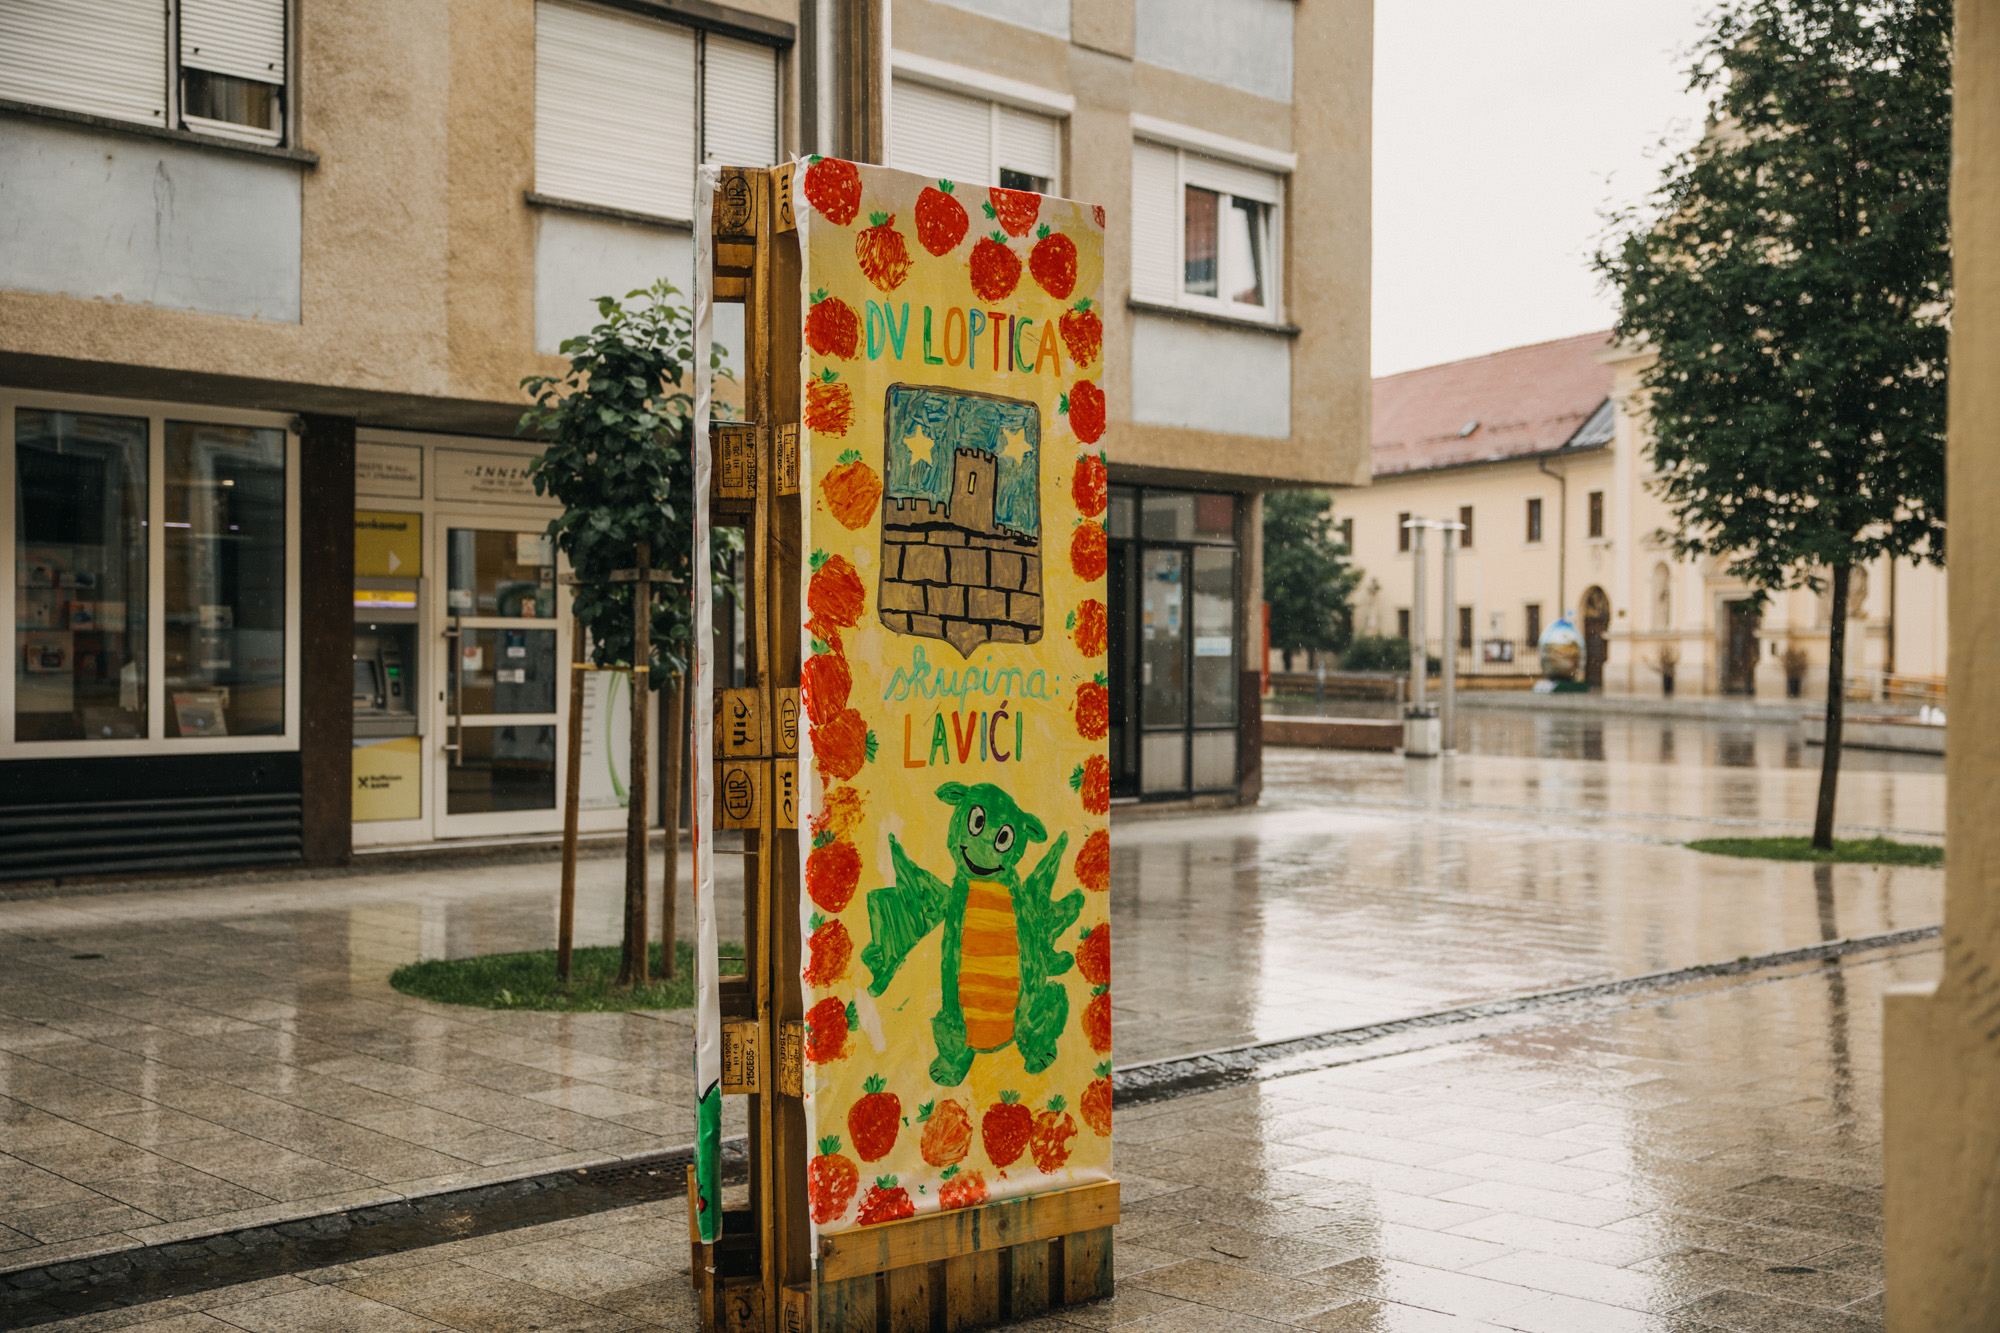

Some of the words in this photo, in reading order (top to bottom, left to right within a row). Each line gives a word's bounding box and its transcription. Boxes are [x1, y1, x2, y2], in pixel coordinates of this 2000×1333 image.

[865, 299, 910, 362] DV
[923, 305, 1061, 378] LOPTICA
[884, 644, 1060, 716] skupina:
[783, 709, 796, 739] EUR
[903, 699, 1023, 769] LAVIĆI
[728, 780, 748, 809] EUR
[787, 1309, 800, 1333] EU
